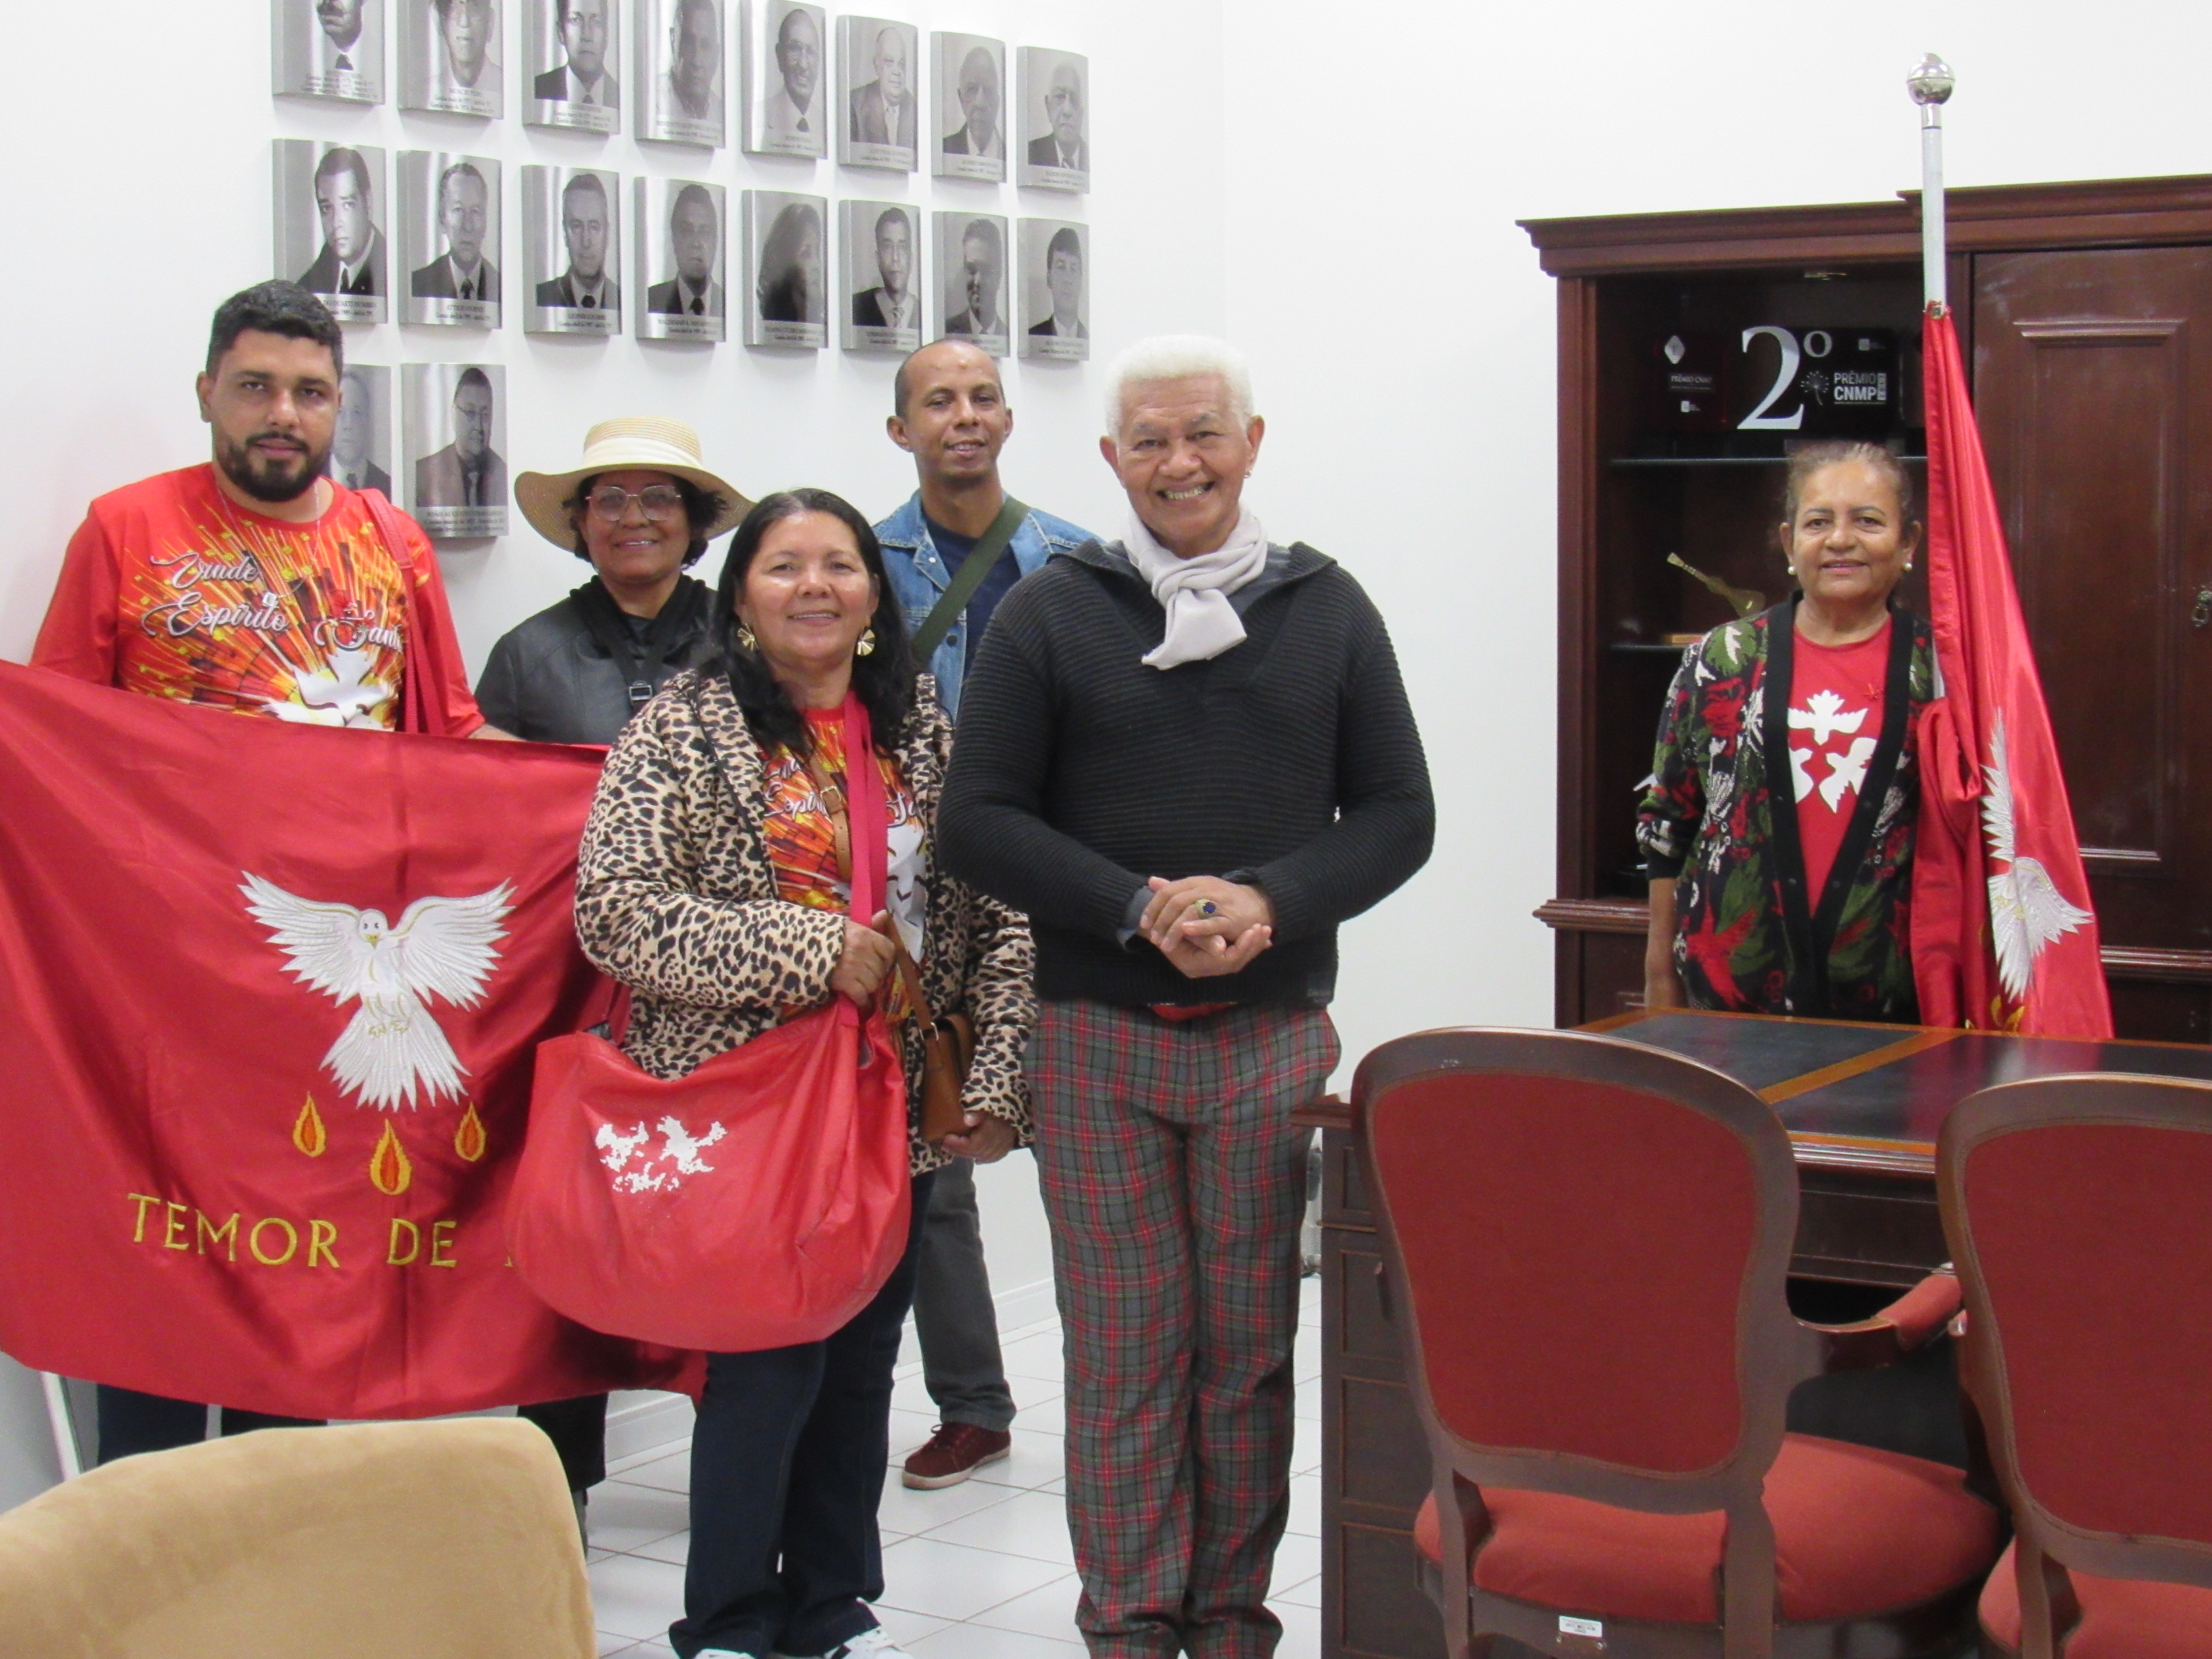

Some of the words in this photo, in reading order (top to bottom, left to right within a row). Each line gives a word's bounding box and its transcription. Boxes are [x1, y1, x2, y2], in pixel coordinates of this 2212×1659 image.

[1834, 370, 1876, 384] PRÊMIO
[1834, 386, 1877, 400] CNMP
[150, 552, 259, 588] Vinde
[128, 1193, 340, 1268] TEMOR
[387, 1218, 457, 1268] DE
